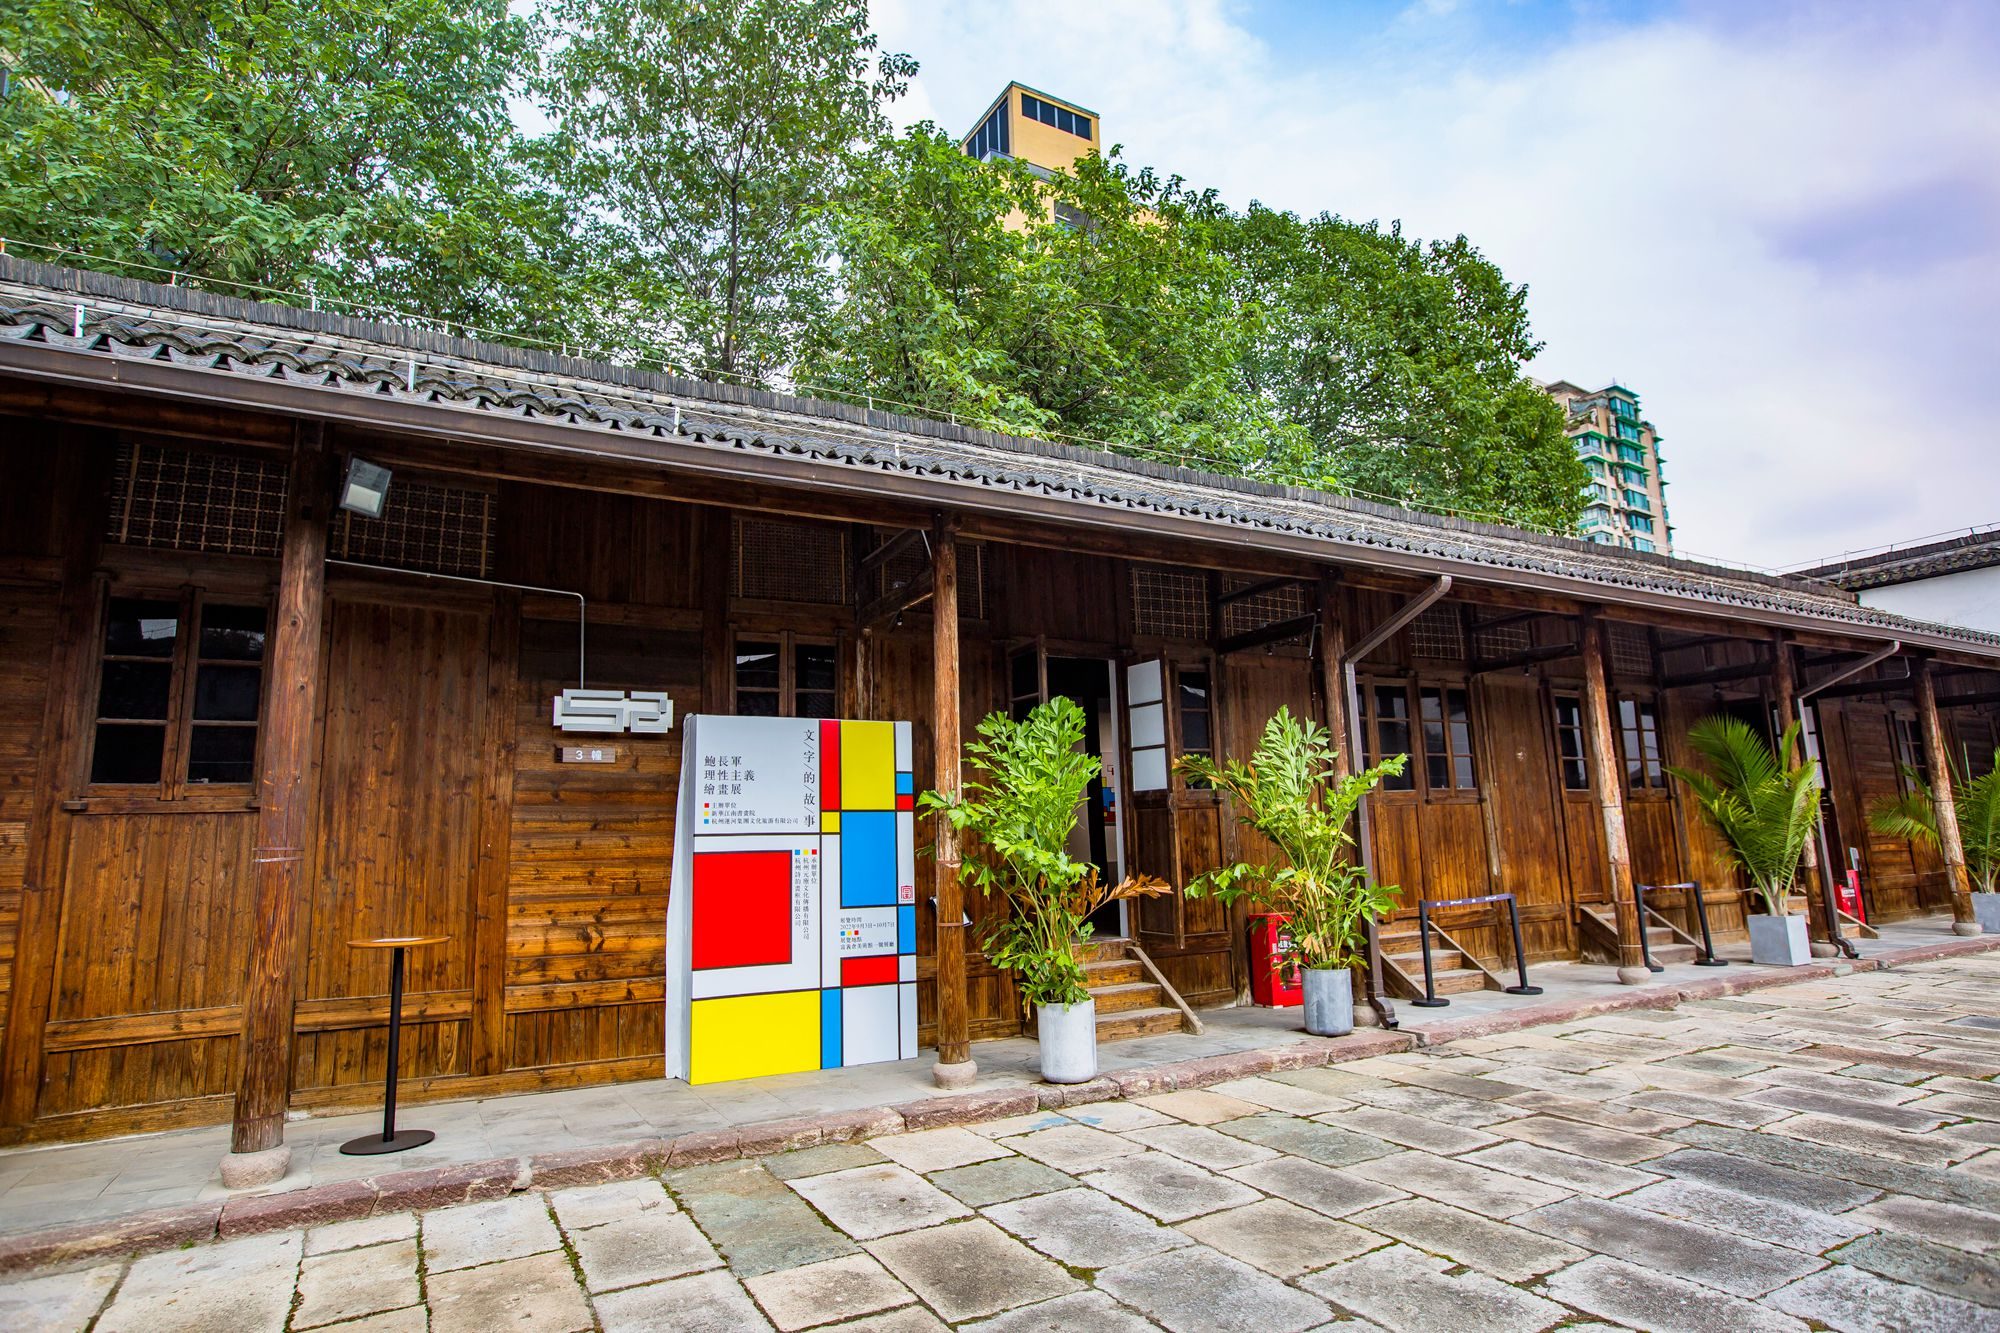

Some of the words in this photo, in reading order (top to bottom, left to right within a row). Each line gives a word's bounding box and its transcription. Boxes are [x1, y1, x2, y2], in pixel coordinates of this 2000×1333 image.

[704, 755, 742, 767] 鮑長軍
[704, 769, 755, 781] 理性主義
[703, 783, 742, 795] 繪畫展
